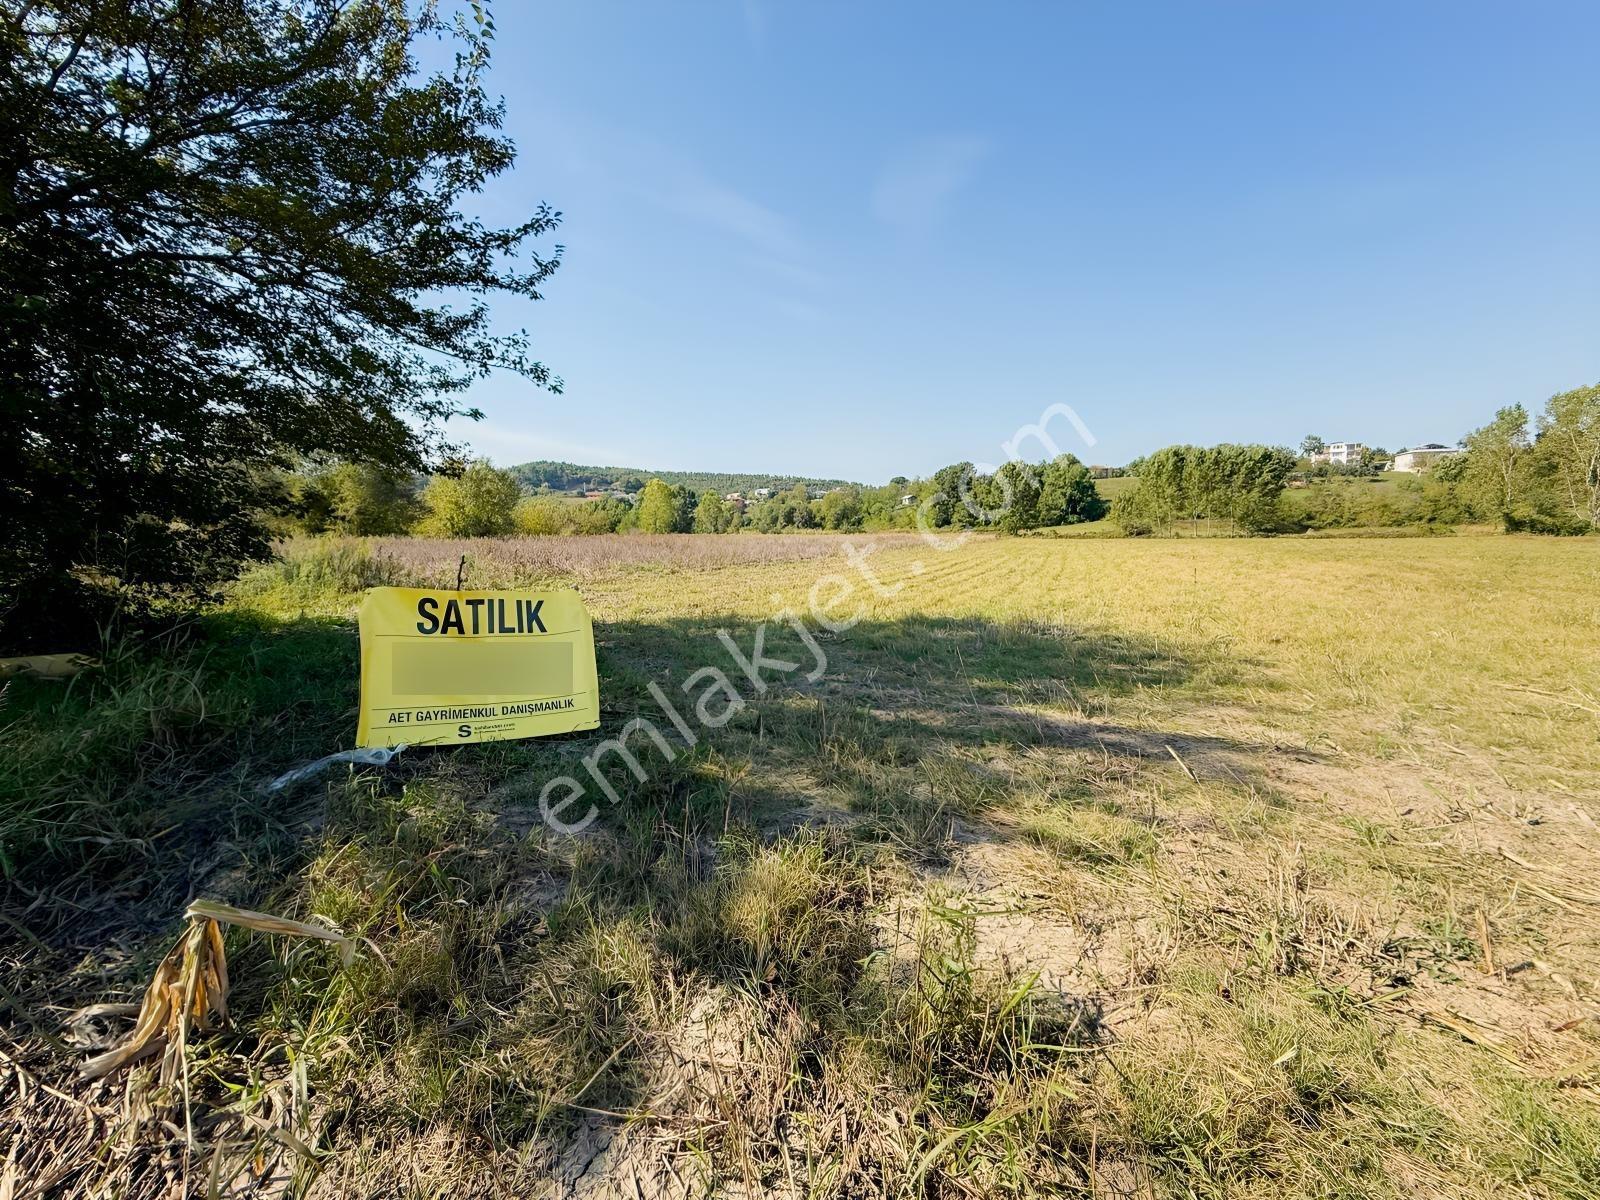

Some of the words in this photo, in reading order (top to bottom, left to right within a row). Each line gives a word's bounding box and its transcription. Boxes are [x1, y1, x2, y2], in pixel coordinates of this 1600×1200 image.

[417, 597, 548, 635] SATILIK
[388, 711, 412, 724] AET
[416, 707, 499, 722] GAYRİMENKUL
[501, 698, 575, 716] DANIŞMANLIK
[458, 724, 472, 738] S
